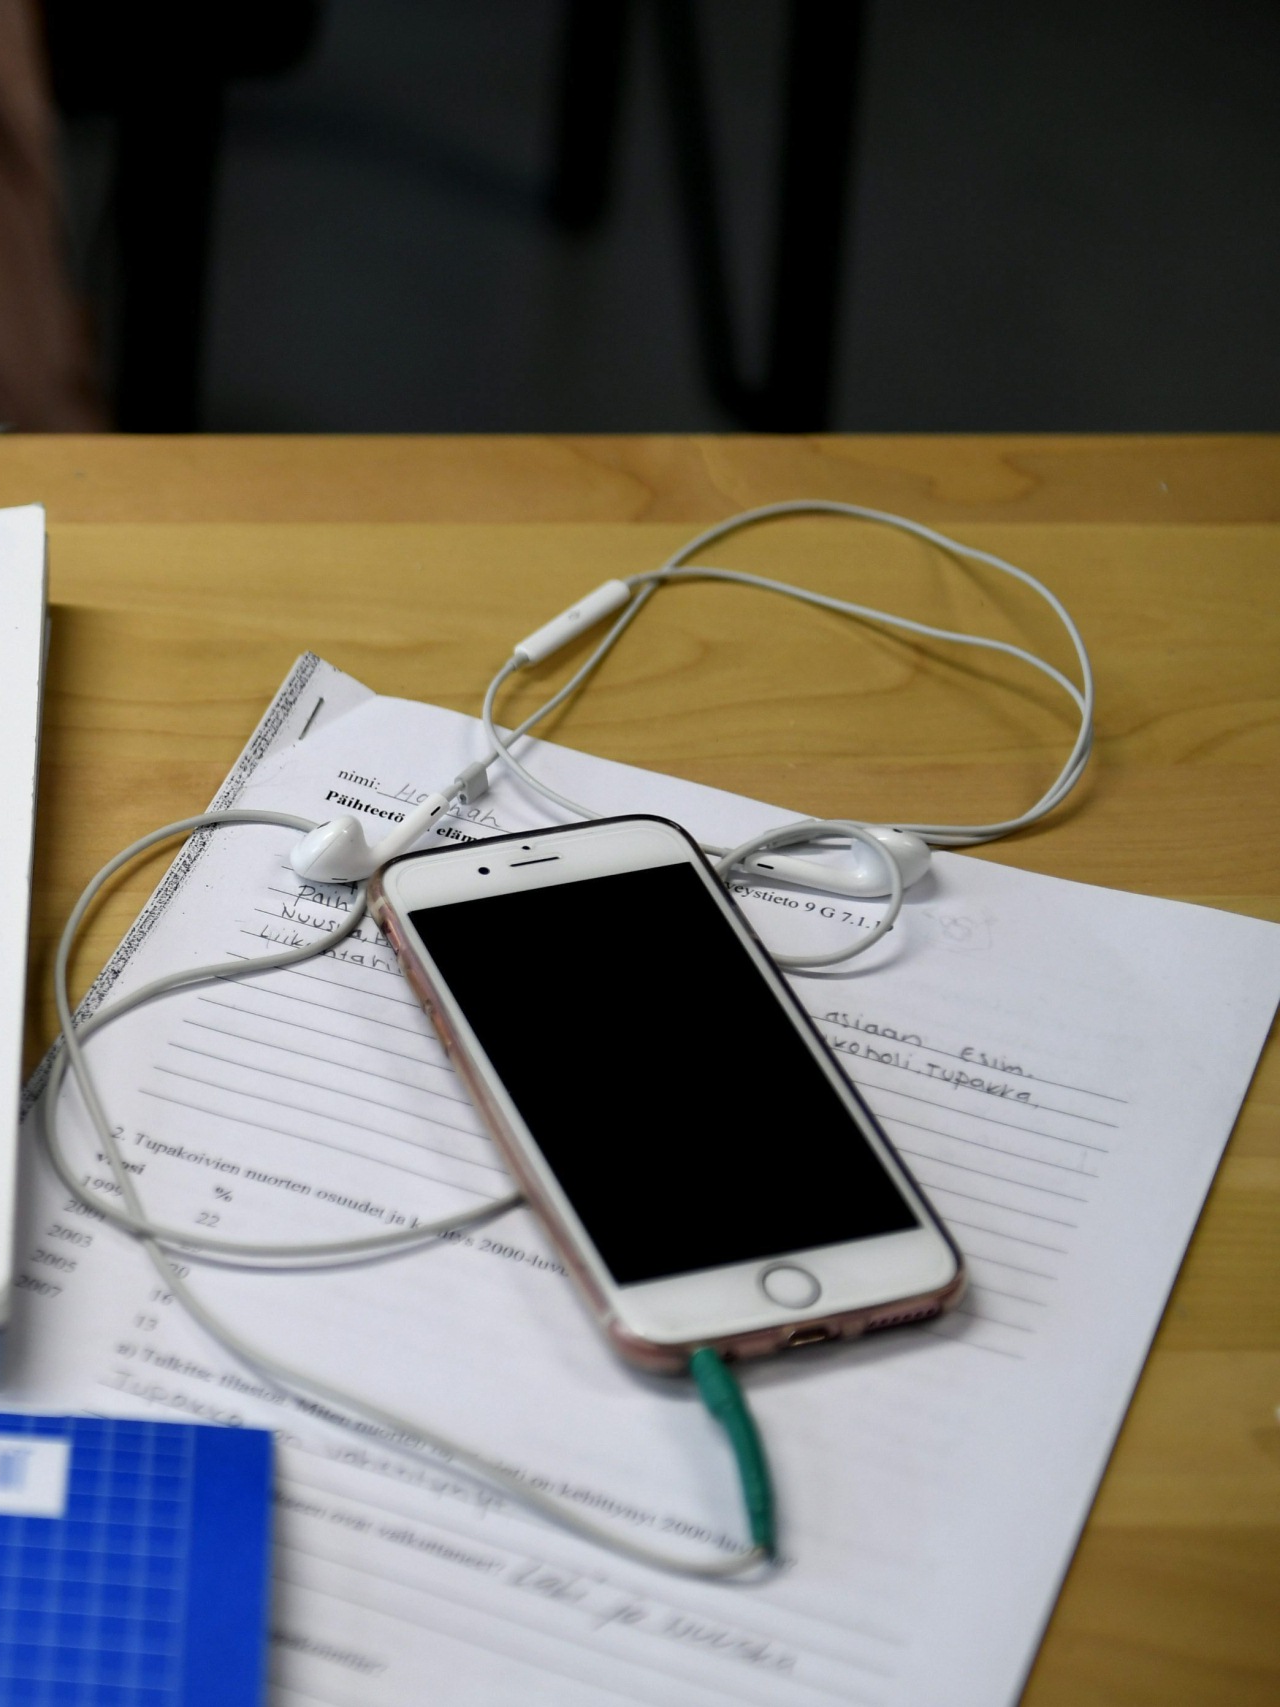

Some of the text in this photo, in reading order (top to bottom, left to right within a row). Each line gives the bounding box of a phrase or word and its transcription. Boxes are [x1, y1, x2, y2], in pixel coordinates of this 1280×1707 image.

[337, 769, 381, 791] nimi:
[324, 789, 429, 832] Päihteetö
[394, 783, 501, 828] Hanah
[298, 884, 350, 912] Päih
[723, 880, 799, 909] veystieto
[805, 901, 816, 913] 9
[820, 906, 836, 920] G
[280, 902, 370, 943] Nuusa,
[825, 1012, 923, 1047] asiaan
[132, 1132, 241, 1176] Tupakoivien
[243, 1167, 312, 1196] nuorten
[46, 1225, 94, 1249] 2003
[194, 1212, 221, 1229] 22
